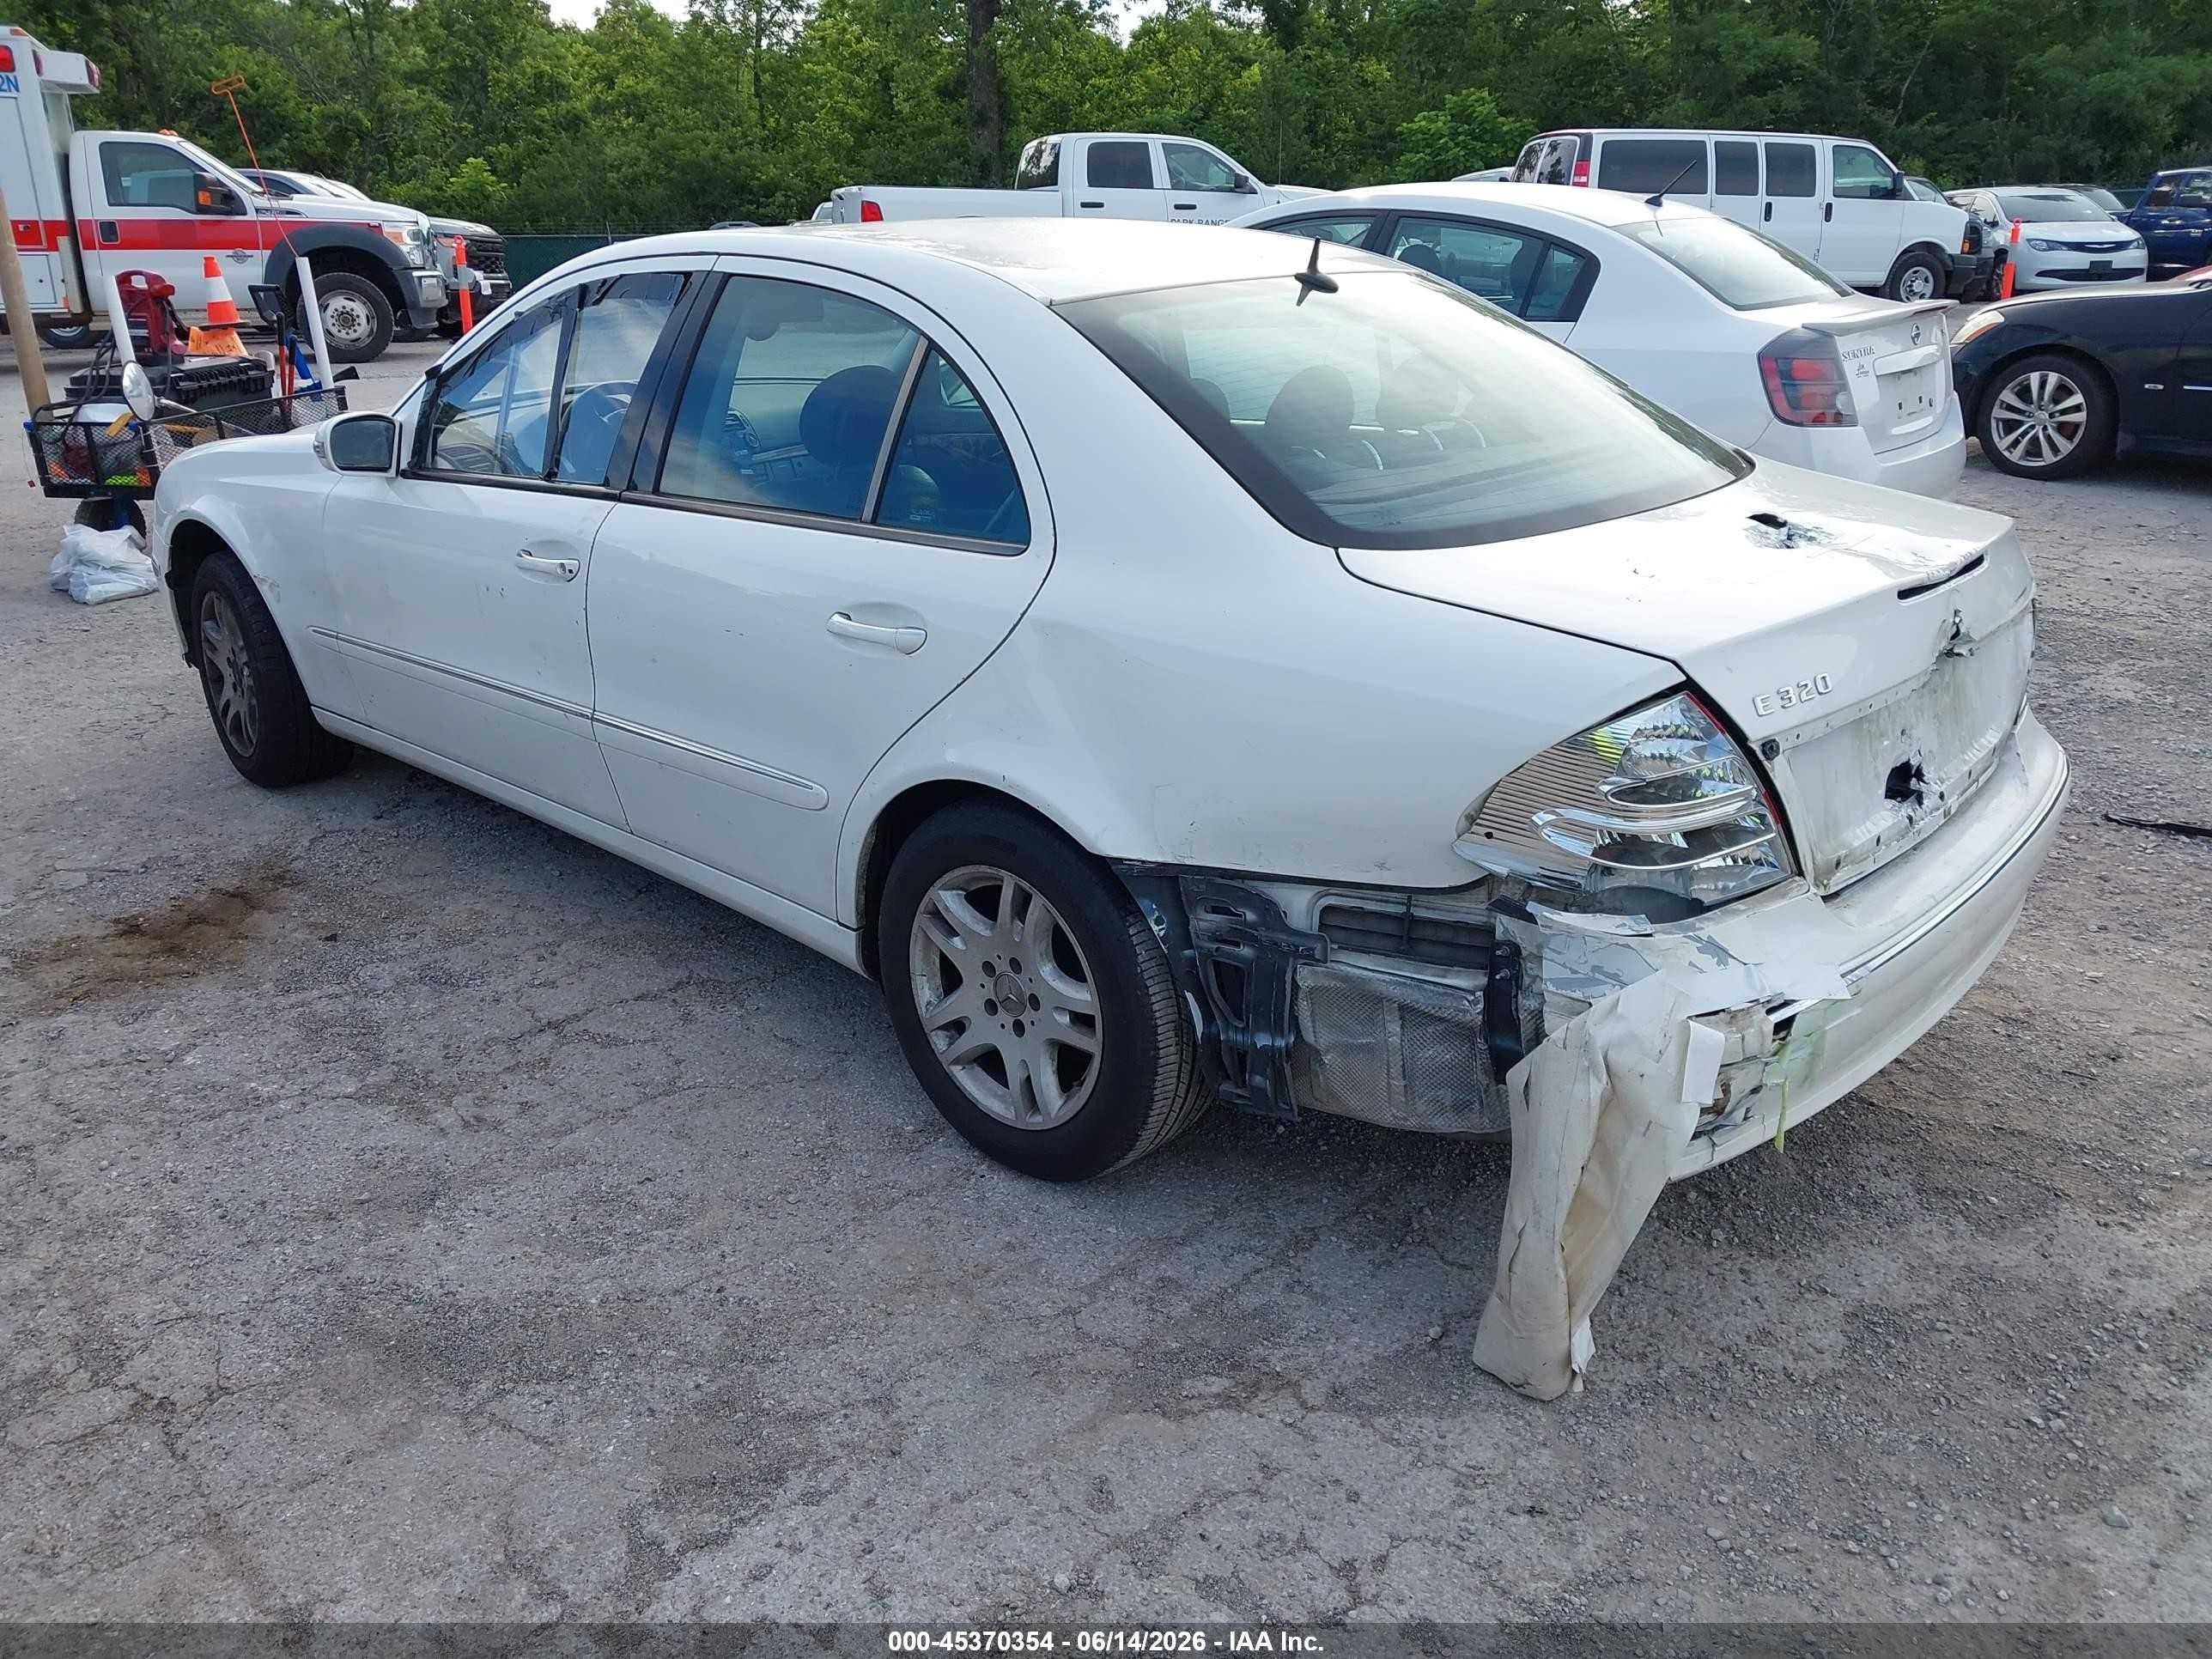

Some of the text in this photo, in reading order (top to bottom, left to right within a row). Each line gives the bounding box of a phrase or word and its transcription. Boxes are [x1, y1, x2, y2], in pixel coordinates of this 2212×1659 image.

[1841, 345, 1875, 361] SENTRA
[1753, 672, 1832, 717] E 320
